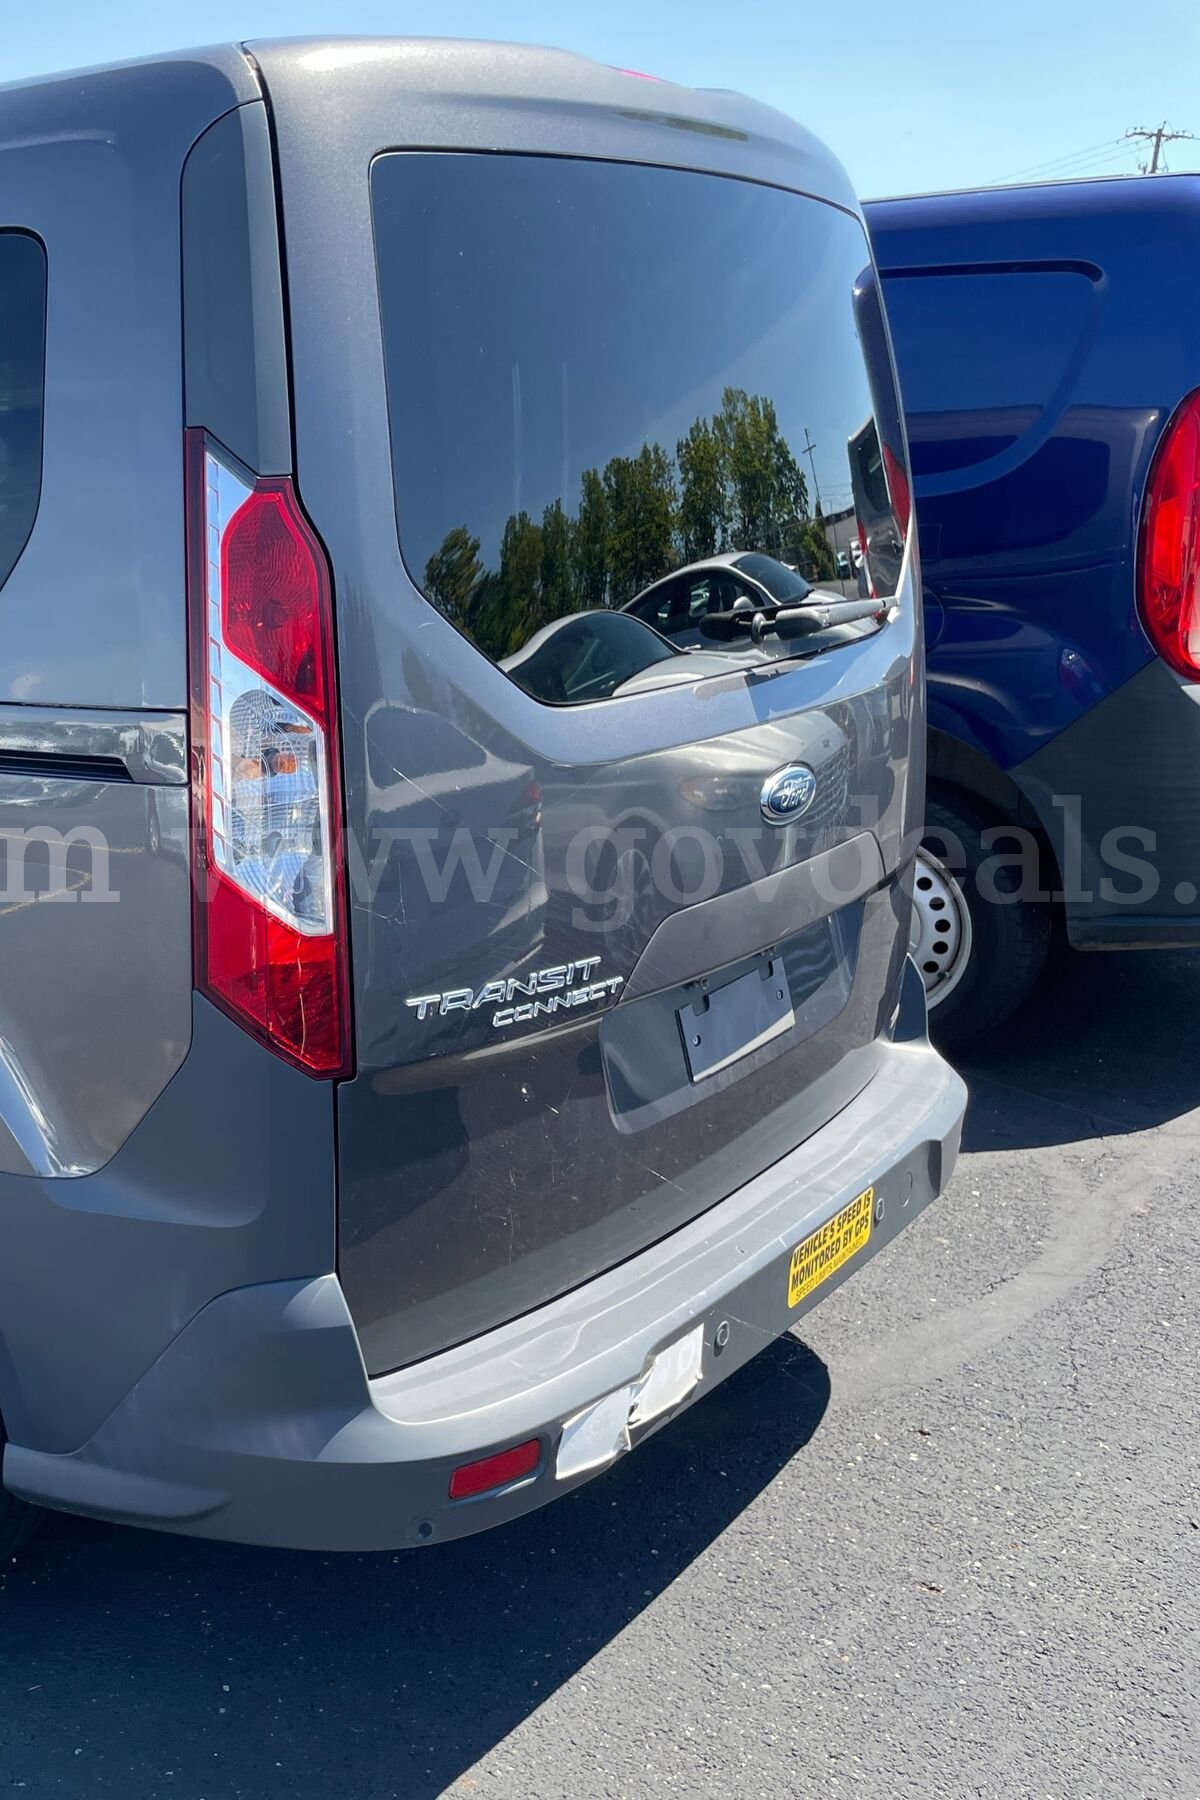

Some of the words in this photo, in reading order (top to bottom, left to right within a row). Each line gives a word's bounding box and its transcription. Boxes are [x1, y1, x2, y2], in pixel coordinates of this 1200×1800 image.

[768, 771, 815, 812] Ford
[405, 956, 601, 1020] TRANSIT
[492, 976, 624, 1028] CONNECT
[791, 1237, 842, 1292] MONITORED
[842, 1224, 854, 1249] BY
[854, 1210, 870, 1238] GPS
[793, 1220, 835, 1269] VEHICLE'S
[836, 1198, 862, 1233] SPEED
[863, 1190, 872, 1211] IS
